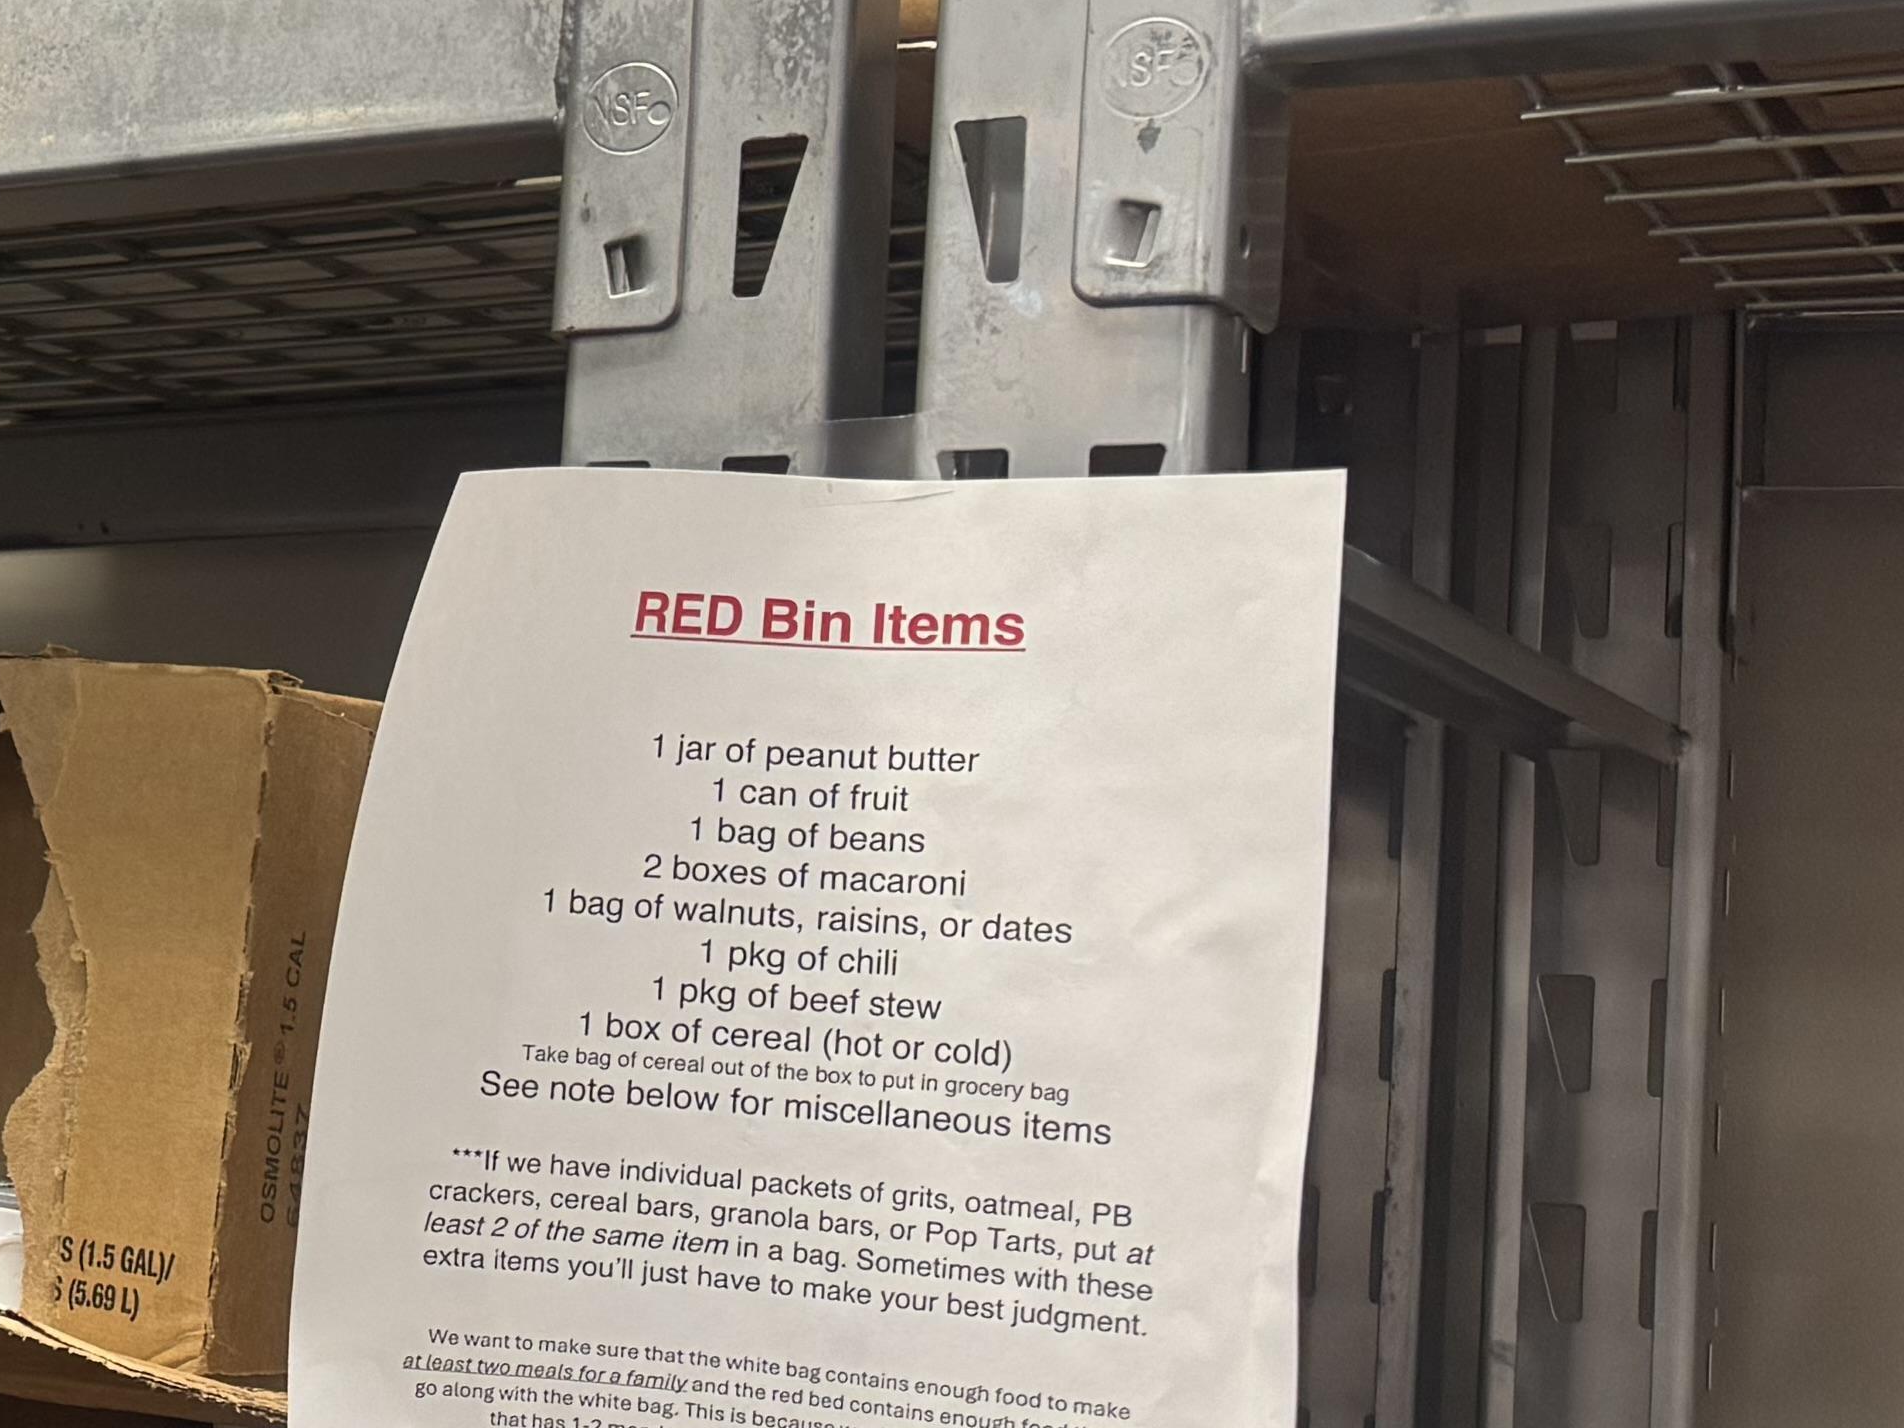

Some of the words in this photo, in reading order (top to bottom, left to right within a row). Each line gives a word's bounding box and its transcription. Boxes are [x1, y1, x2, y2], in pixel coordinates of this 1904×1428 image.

[634, 590, 744, 638] RED
[761, 597, 853, 645] Bin
[872, 601, 1026, 649] Items
[652, 733, 664, 759] 1
[674, 733, 717, 767] jar
[725, 737, 757, 764] of
[765, 745, 879, 773] peanut
[888, 743, 981, 773] butter
[712, 776, 725, 803] 1
[739, 784, 797, 808] can
[808, 782, 841, 809] of
[849, 783, 910, 812] fruit
[690, 815, 702, 842] 1
[717, 816, 776, 853] bag
[787, 822, 820, 849] of
[829, 822, 926, 854] beans
[642, 852, 662, 880] 2
[672, 853, 767, 886] boxes
[777, 861, 810, 889] of
[819, 869, 967, 897] macaroni
[543, 887, 555, 914] 1
[569, 887, 624, 924] bag
[634, 893, 665, 920] of
[673, 897, 803, 934] walnuts,
[817, 905, 927, 941] raisins,
[939, 916, 974, 939] or
[982, 912, 1073, 944] dates
[700, 938, 712, 964] 1
[728, 940, 786, 976] pkg
[797, 945, 829, 972] of
[837, 946, 898, 977] chili
[652, 975, 664, 1001] 1
[679, 977, 737, 1013] pkg
[747, 982, 780, 1010] of
[789, 983, 861, 1015] beef
[868, 991, 943, 1020] stew
[579, 1010, 591, 1037] 1
[605, 1011, 662, 1041] box
[671, 1017, 703, 1044] of
[711, 1025, 811, 1053] cereal
[823, 1027, 884, 1062] (hot
[892, 1039, 925, 1061] or
[934, 1037, 1012, 1075] cold)
[79, 1238, 116, 1272] (1.5
[120, 1245, 176, 1286] GAL)/
